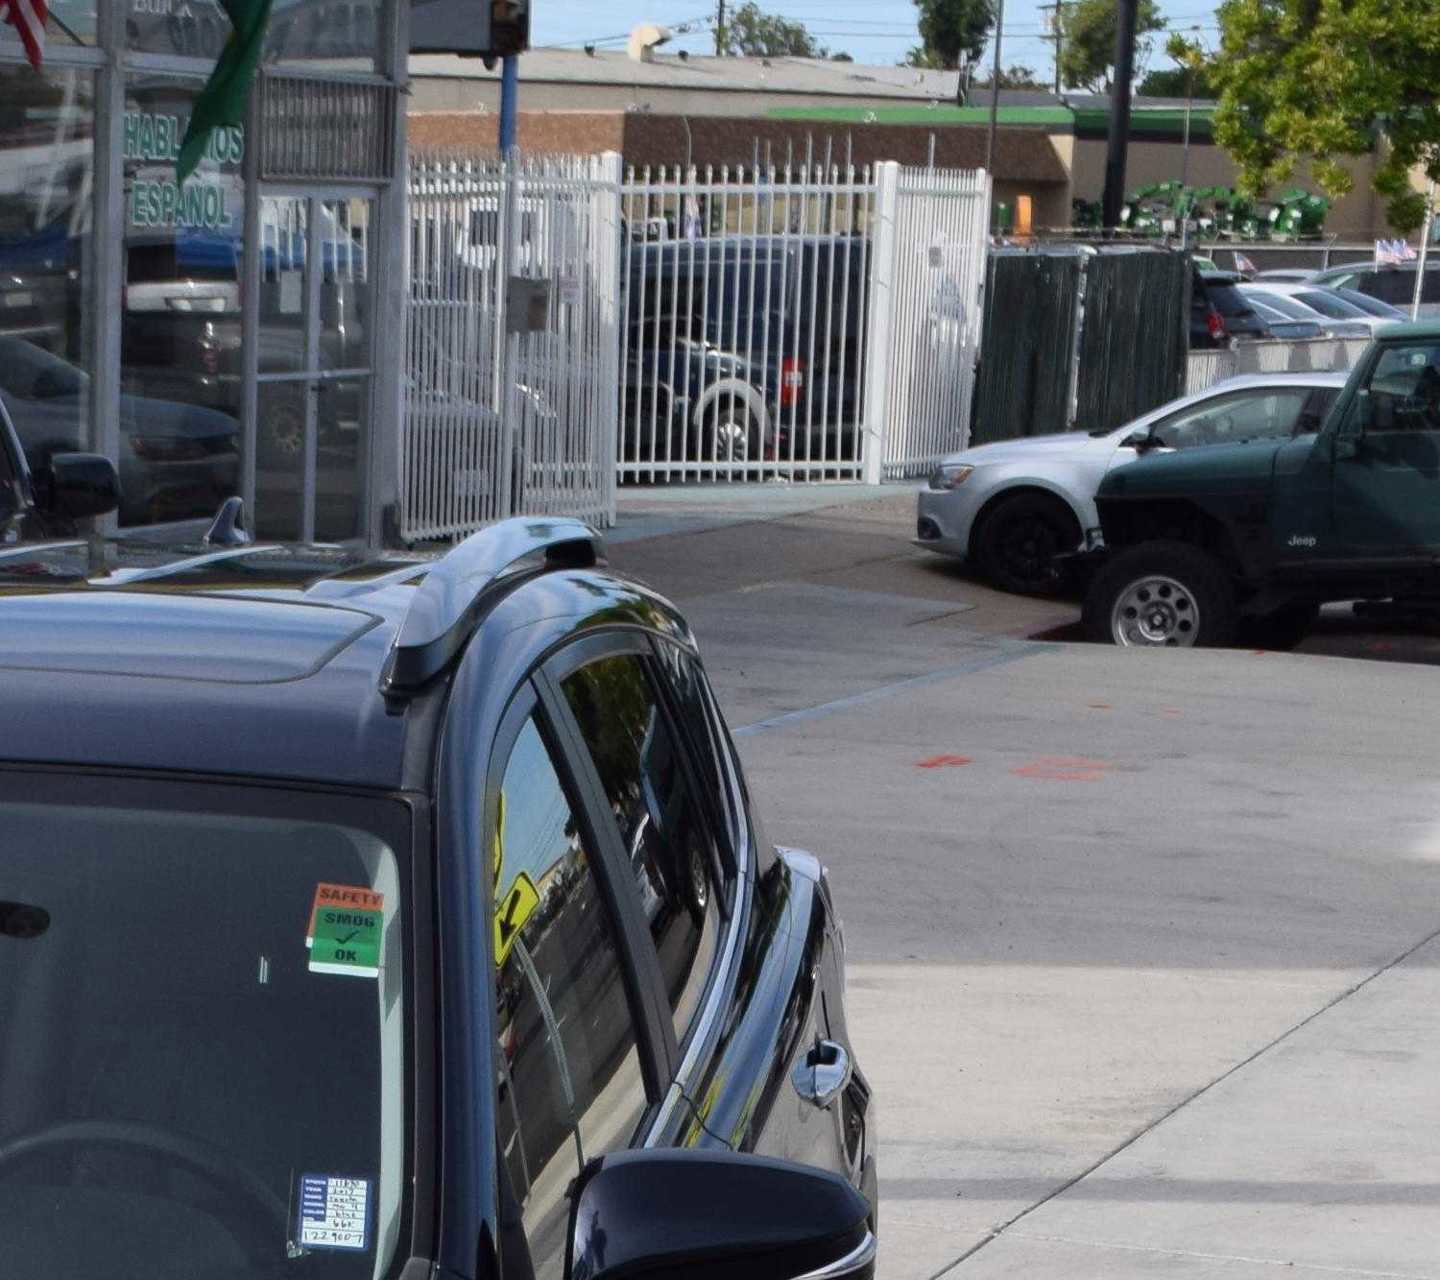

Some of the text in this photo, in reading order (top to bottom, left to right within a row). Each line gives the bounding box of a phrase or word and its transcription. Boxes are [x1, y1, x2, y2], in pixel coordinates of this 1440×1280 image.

[123, 112, 245, 164] HABLOS
[1288, 534, 1317, 548] Jeep
[320, 887, 381, 905] SAFETY
[323, 912, 375, 928] SMOG
[334, 948, 358, 962] OK
